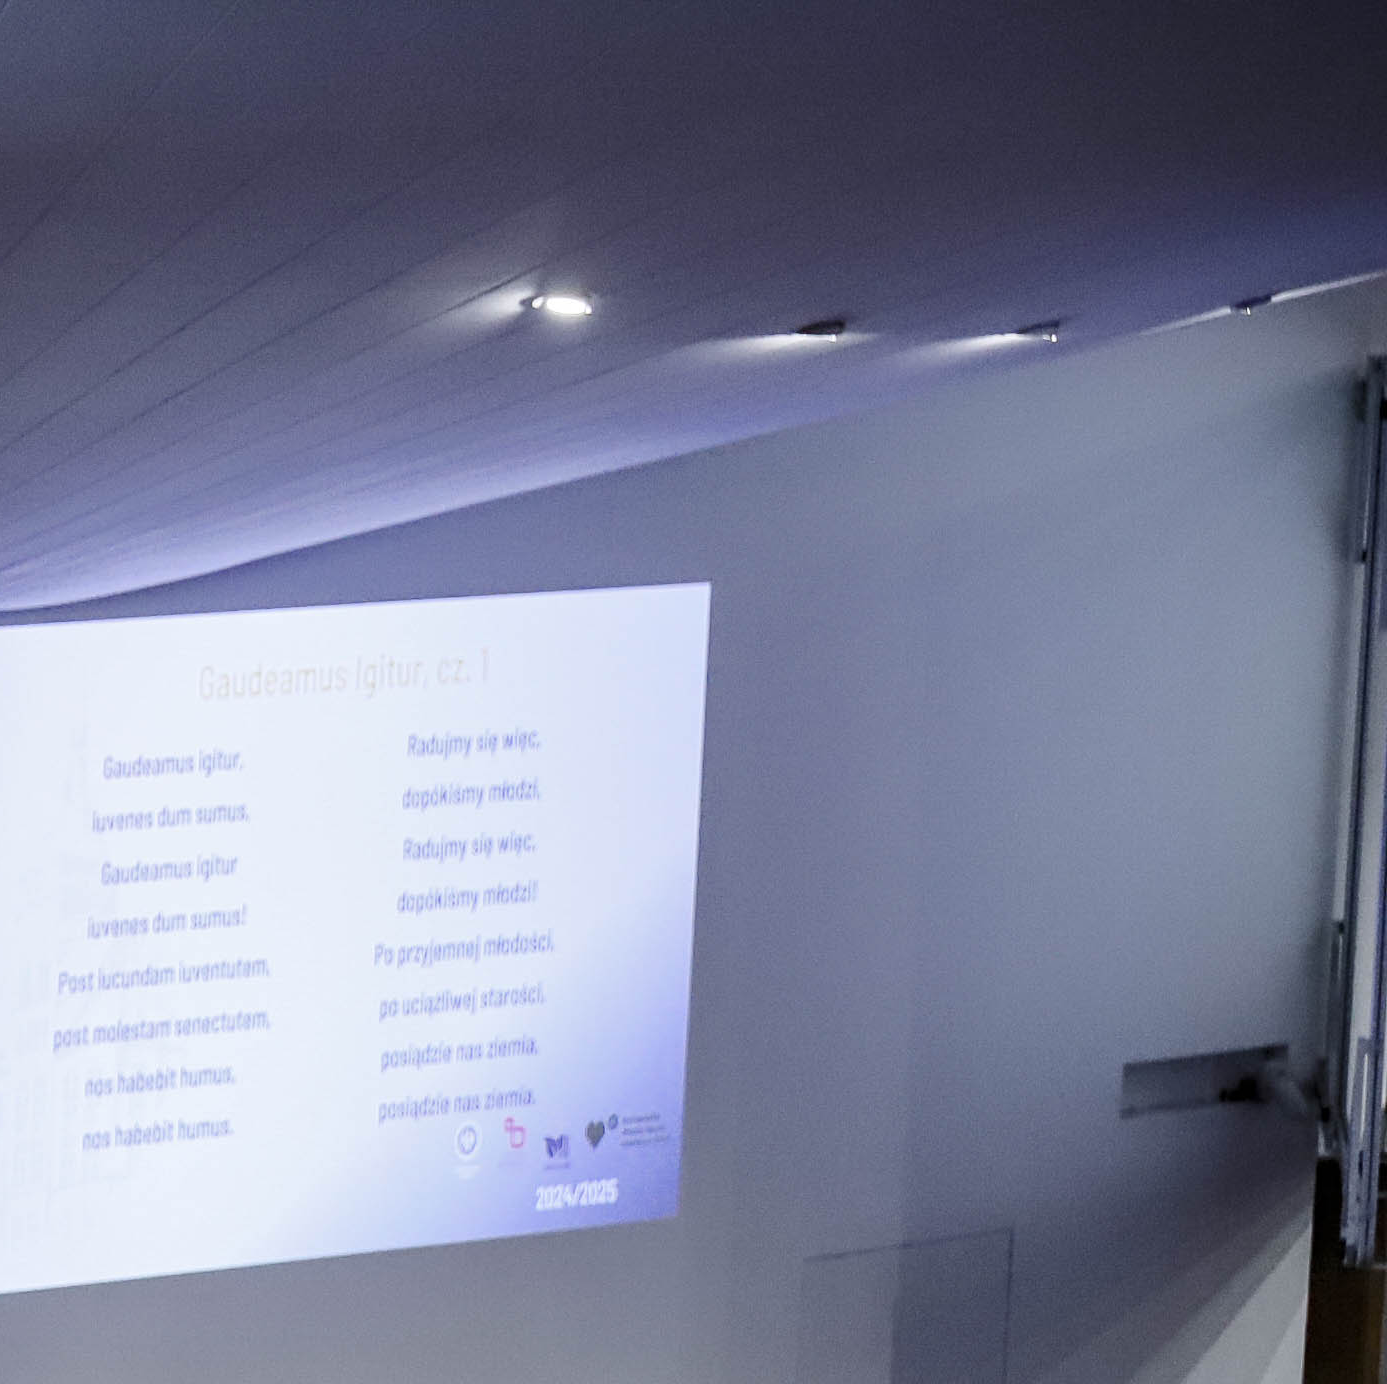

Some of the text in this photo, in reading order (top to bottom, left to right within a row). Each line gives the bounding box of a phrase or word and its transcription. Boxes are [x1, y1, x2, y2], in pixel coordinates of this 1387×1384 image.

[199, 648, 489, 701] Gaudeamus Igitur, cz. 1
[407, 733, 472, 761] Radujmy
[476, 730, 499, 754] się
[102, 754, 195, 780] Gaudeamus
[402, 782, 485, 812] dopókiśmy
[91, 809, 154, 834] iuvenes
[157, 806, 192, 828] dum
[402, 837, 468, 863] Radujmy
[471, 833, 494, 857] się
[100, 854, 238, 886] Gaudeamus igitur
[396, 878, 538, 916] dopókiśmy młodzi!
[87, 902, 247, 940] iuvenes dum sumus!
[373, 942, 394, 966] Po
[396, 934, 481, 969] przyjemnej
[57, 970, 95, 995] Post
[97, 964, 176, 991] iucundam
[378, 998, 400, 1022] po
[402, 989, 476, 1017] uciążliwej
[52, 1024, 89, 1054] post
[92, 1018, 172, 1044] molestam
[380, 1042, 452, 1073] posiądzie
[456, 1042, 484, 1061] nas
[84, 1077, 114, 1098] nos
[116, 1066, 177, 1094] habebit
[378, 1088, 537, 1125] posiądzie nas ziemia.
[82, 1118, 234, 1151] nos habebit humus.
[536, 1178, 619, 1211] 2024/2025
